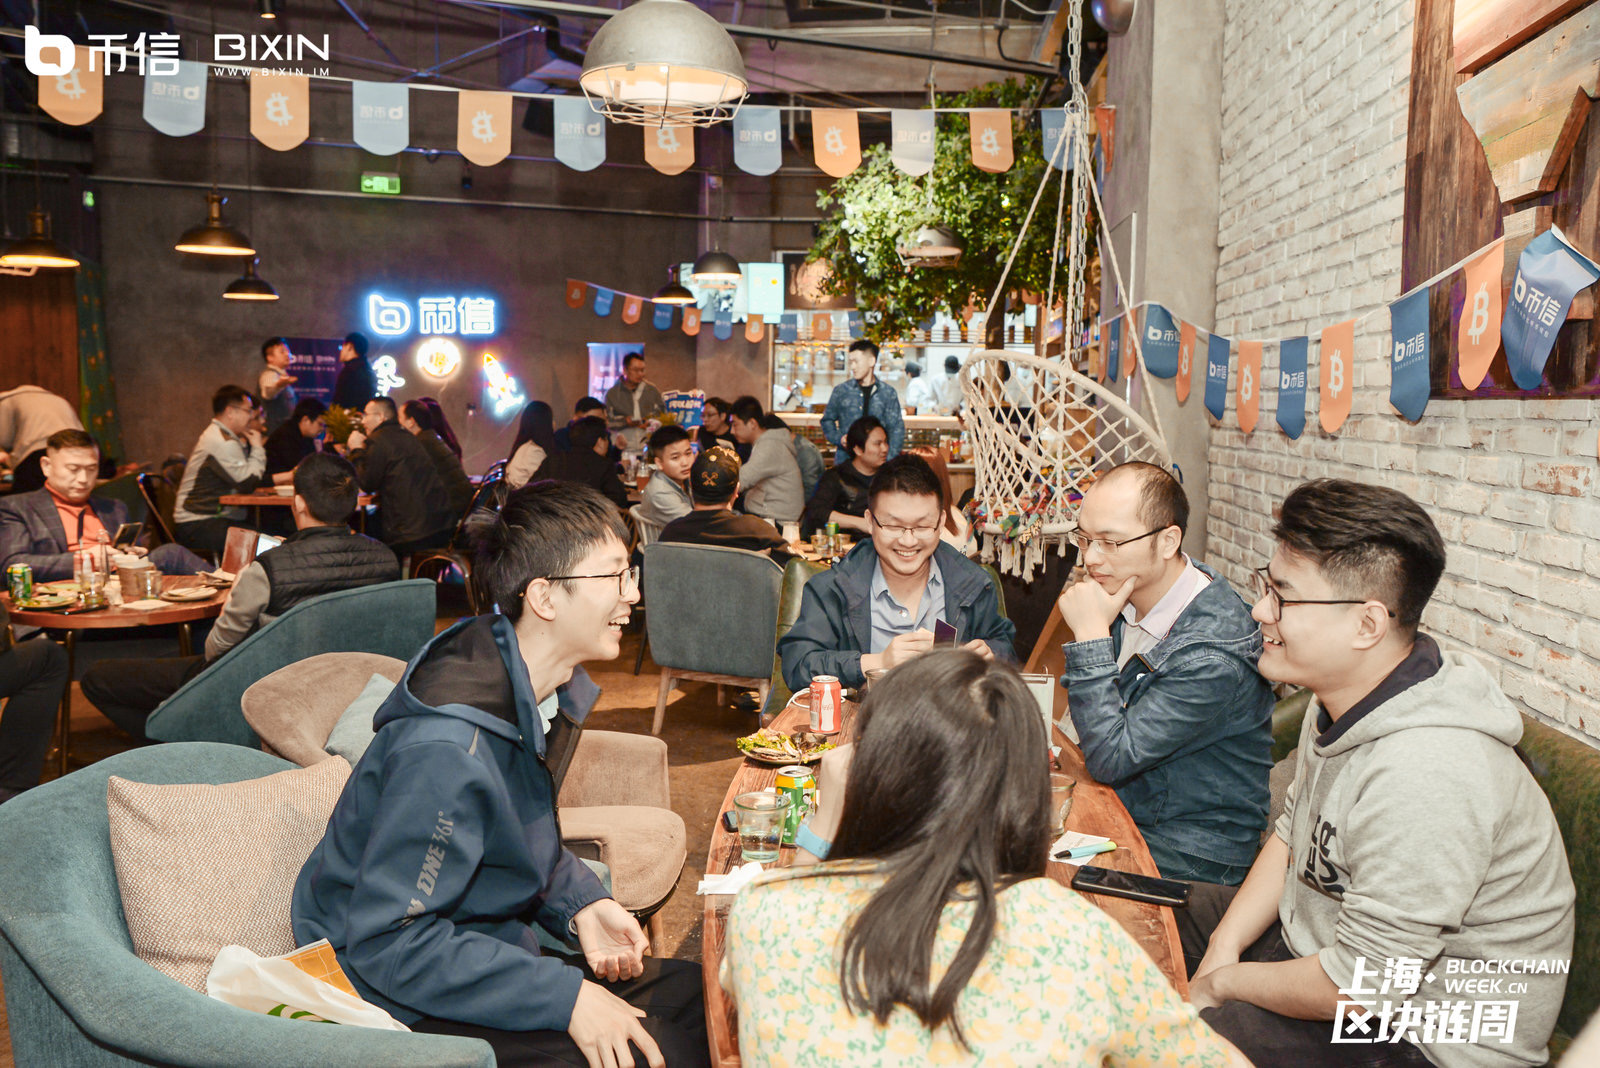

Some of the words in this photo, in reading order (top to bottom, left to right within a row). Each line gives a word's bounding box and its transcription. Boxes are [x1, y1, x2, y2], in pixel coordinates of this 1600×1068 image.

[419, 297, 495, 335] 币信
[1525, 287, 1561, 327] 币信
[416, 843, 446, 897] ONE
